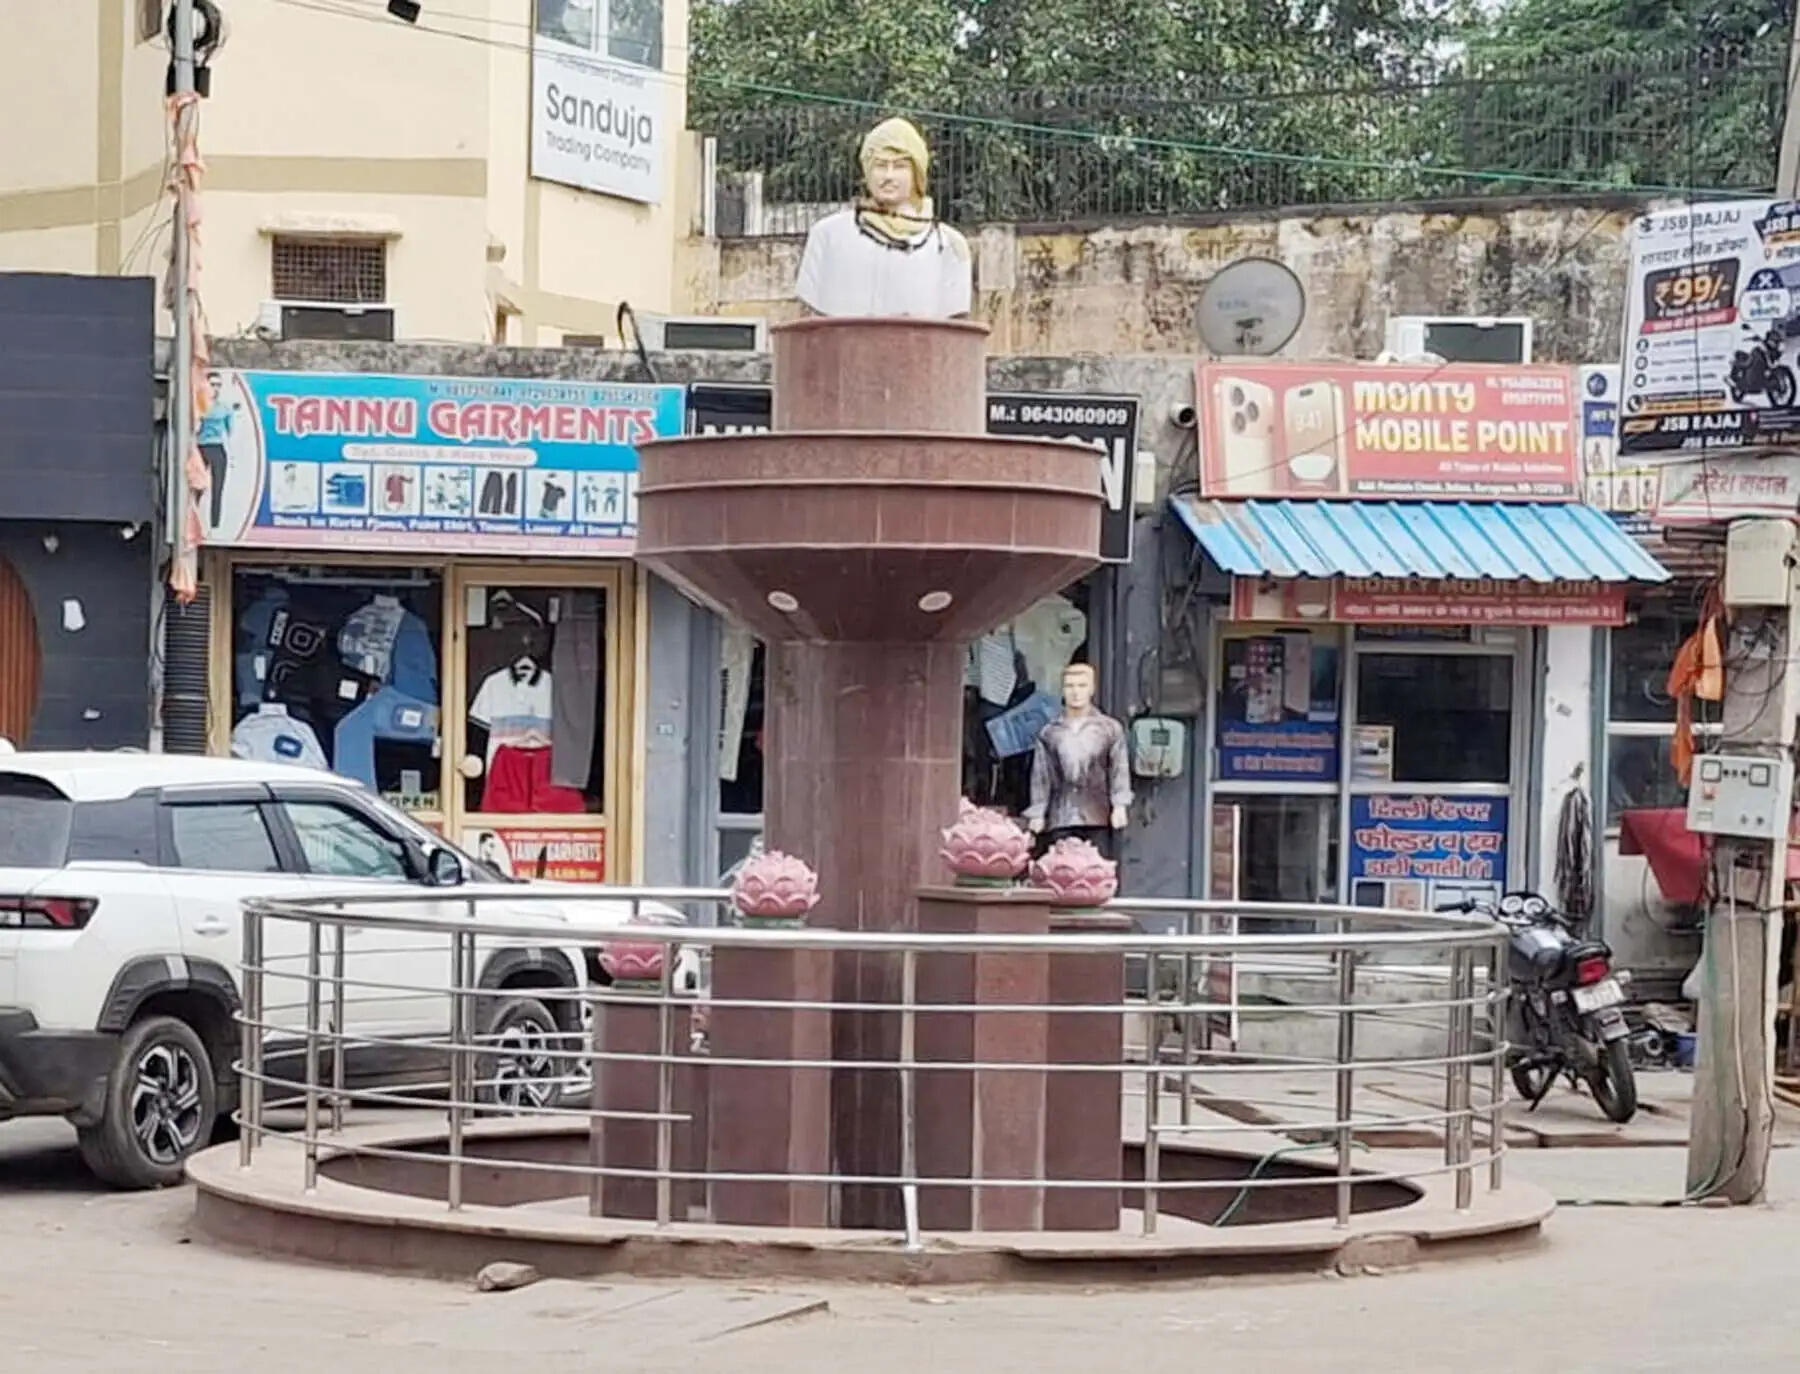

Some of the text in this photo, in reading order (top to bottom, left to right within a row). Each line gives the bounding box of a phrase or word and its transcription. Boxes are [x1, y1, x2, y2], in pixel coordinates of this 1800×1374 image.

[546, 82, 653, 148] Sanduja
[546, 130, 651, 174] Trading Company
[1691, 209, 1741, 229] BAJAJ
[268, 395, 658, 446] TANNU GARMENTS
[1021, 405, 1128, 425] 9643060909
[1660, 416, 1689, 431] JSB
[1692, 413, 1742, 430] BAJAJ
[1355, 418, 1569, 453] MOBILE POINT
[1369, 796, 1429, 820] दिल्ली
